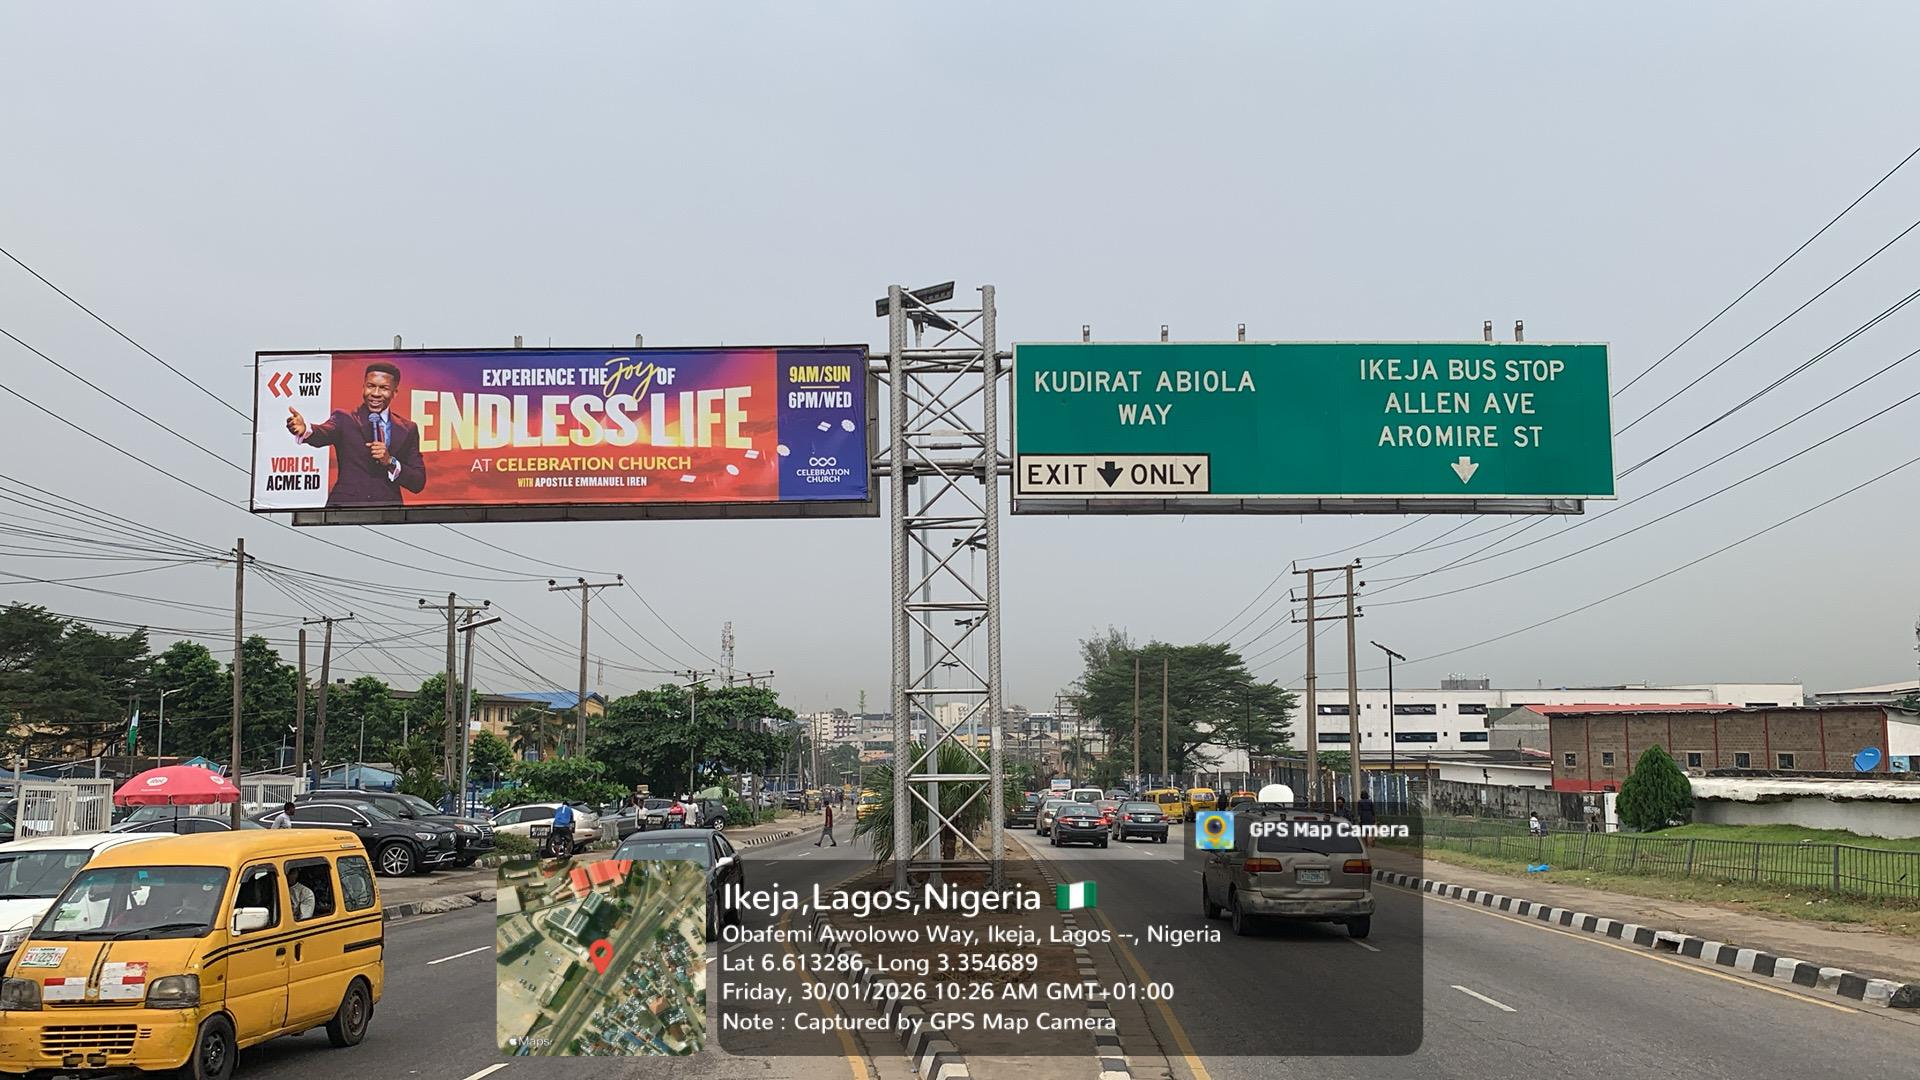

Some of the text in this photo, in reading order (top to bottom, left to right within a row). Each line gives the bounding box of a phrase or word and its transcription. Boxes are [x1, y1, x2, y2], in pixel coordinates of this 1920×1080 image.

[298, 372, 322, 384] THIS
[482, 357, 676, 401] EXPERIENCE THE Joy OF
[789, 365, 851, 383] 9AM/SUN
[1360, 359, 1566, 382] IKEJA BUS STOP
[1034, 370, 1256, 392] KUDIRAT ABIOLA
[298, 385, 321, 397] WAY
[788, 391, 852, 409] 6PM/WED
[1384, 392, 1536, 414] ALLEN AVE
[410, 386, 752, 453] ENDLESS LIFE
[1117, 404, 1173, 425] WAY
[1378, 425, 1544, 448] AROMIRE ST
[271, 456, 319, 474] VORI CL,
[470, 456, 691, 472] AT CELEBRATION CHURCH
[796, 468, 850, 476] CELEBRATION
[266, 474, 321, 491] ACME RD
[517, 476, 647, 488] WITH APOSTLE EMMANUEL IREN
[806, 475, 840, 483] CHURCH
[1027, 463, 1203, 485] EXIT ONLY
